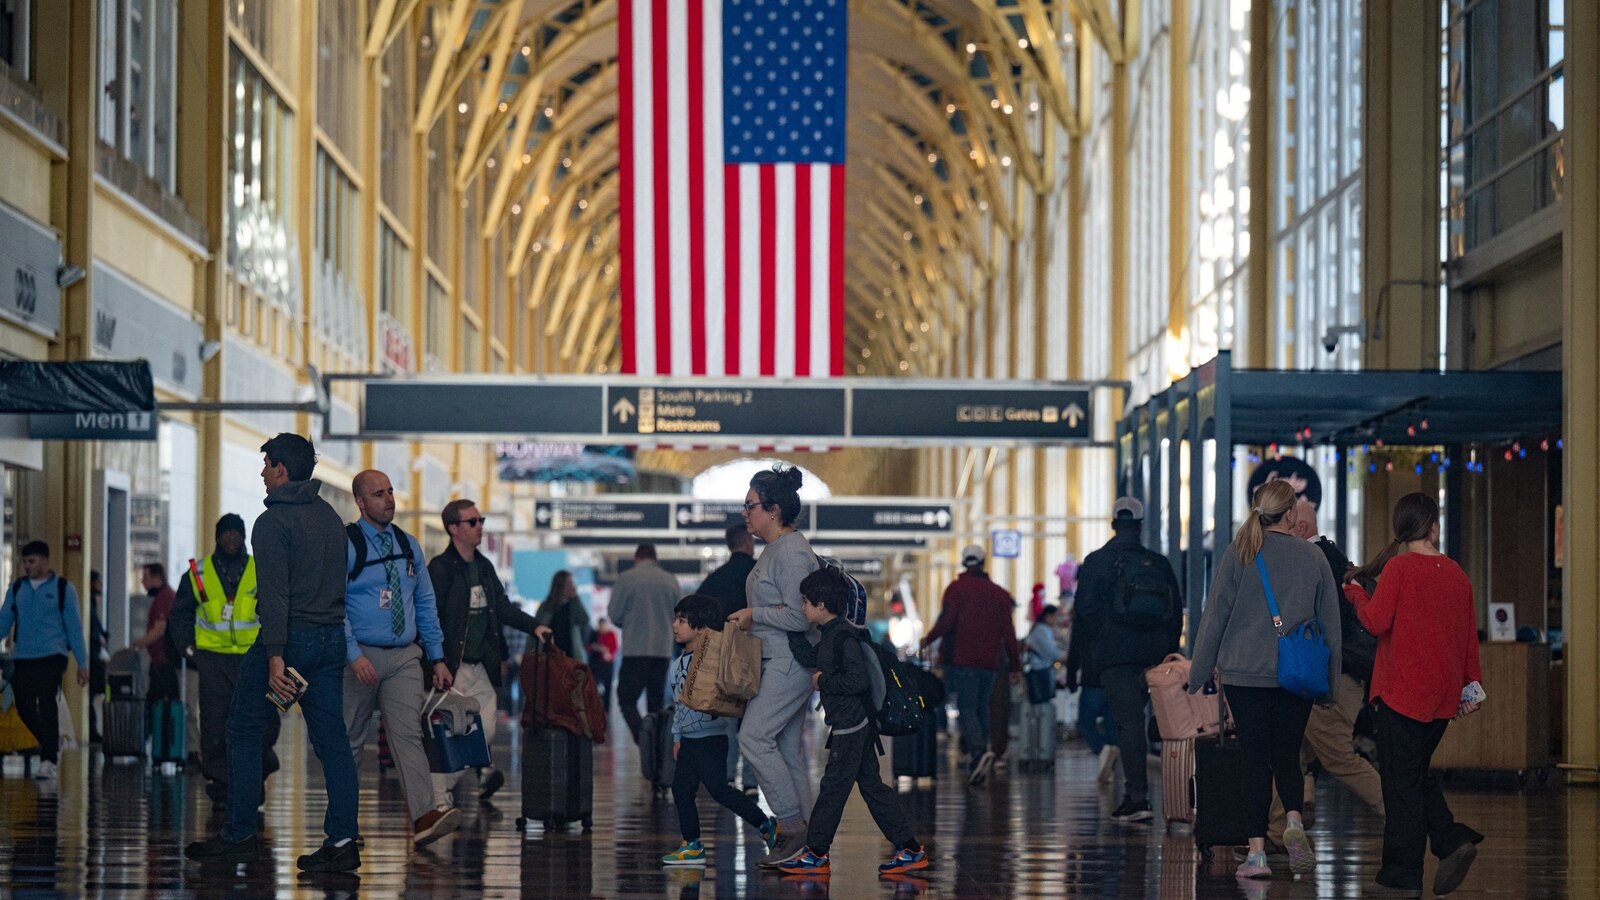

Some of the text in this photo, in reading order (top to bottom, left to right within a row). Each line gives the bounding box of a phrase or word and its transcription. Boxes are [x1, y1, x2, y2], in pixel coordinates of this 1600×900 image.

[657, 389, 753, 405] South Parking 2
[657, 404, 696, 417] Metro
[75, 411, 124, 429] Men
[657, 418, 721, 432] Restrooms
